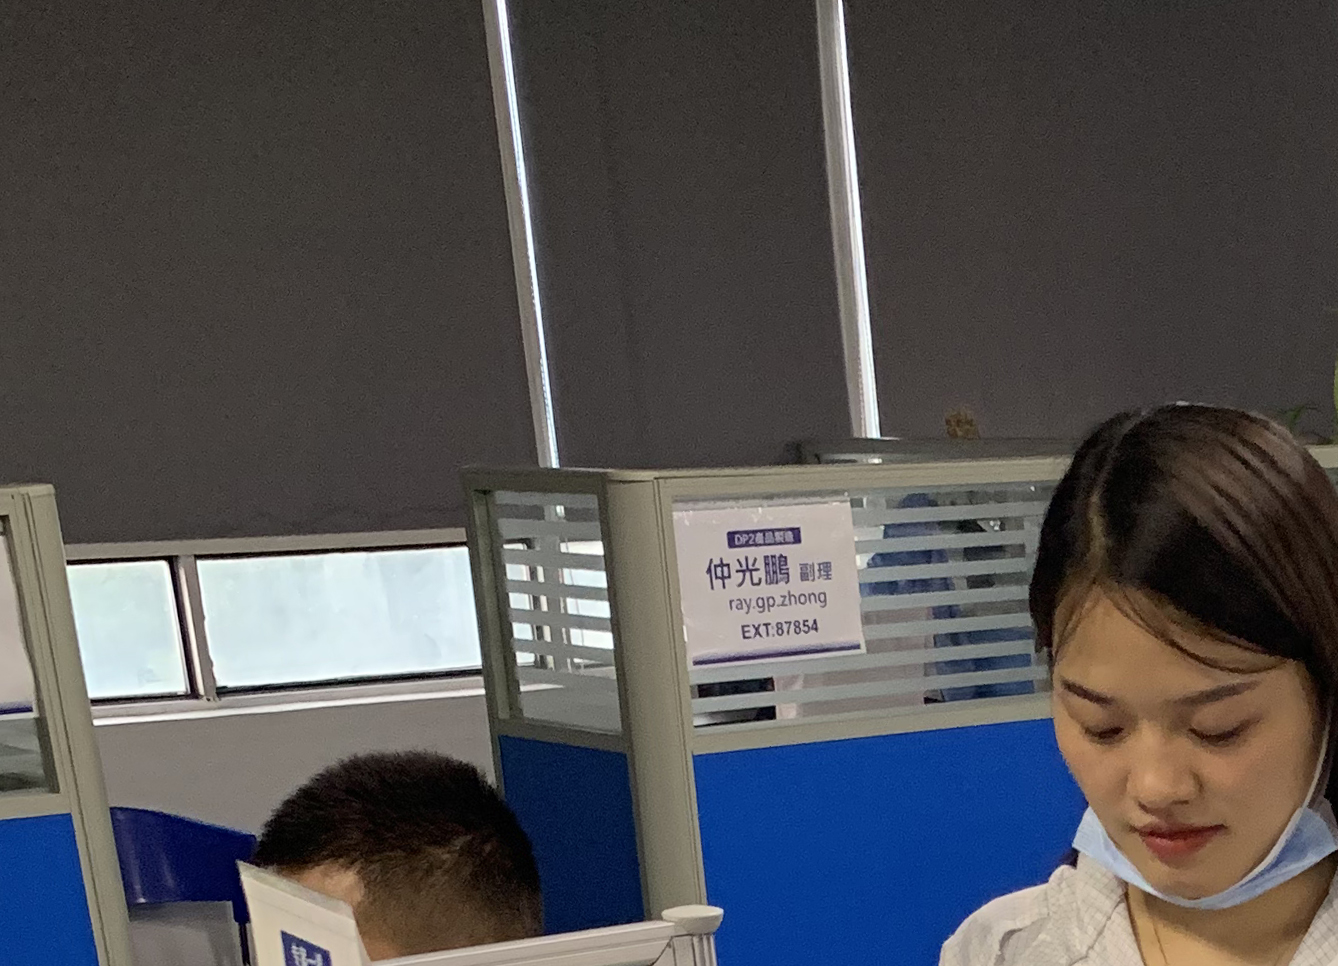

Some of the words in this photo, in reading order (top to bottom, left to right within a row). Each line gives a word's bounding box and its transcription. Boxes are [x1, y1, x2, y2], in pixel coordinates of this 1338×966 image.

[705, 553, 790, 590] 仲光鵬
[799, 560, 833, 583] 副理
[729, 590, 828, 615] ray.gp.zhong
[740, 618, 820, 640] EXT:87854
